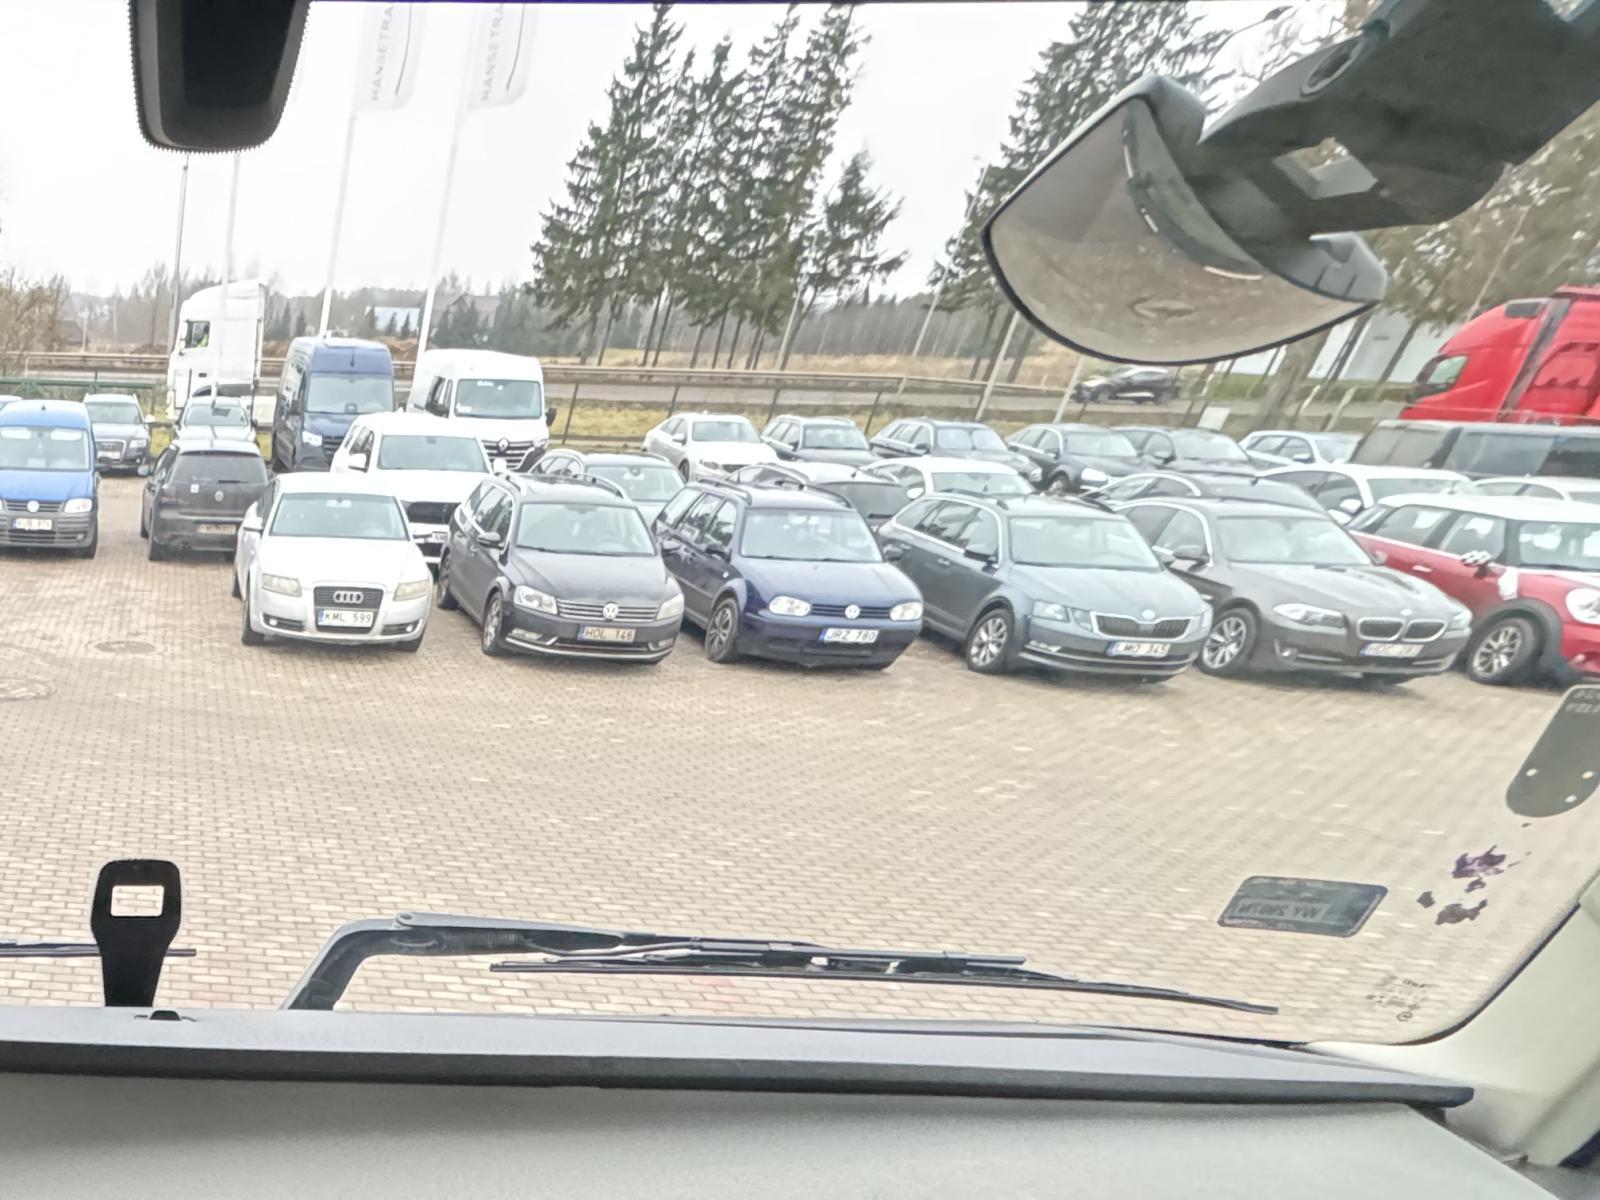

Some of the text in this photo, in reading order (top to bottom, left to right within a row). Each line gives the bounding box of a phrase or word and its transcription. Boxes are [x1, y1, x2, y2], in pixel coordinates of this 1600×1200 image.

[325, 611, 372, 624] KML 599
[585, 627, 633, 641] HOL 146
[828, 629, 851, 641] JRZ
